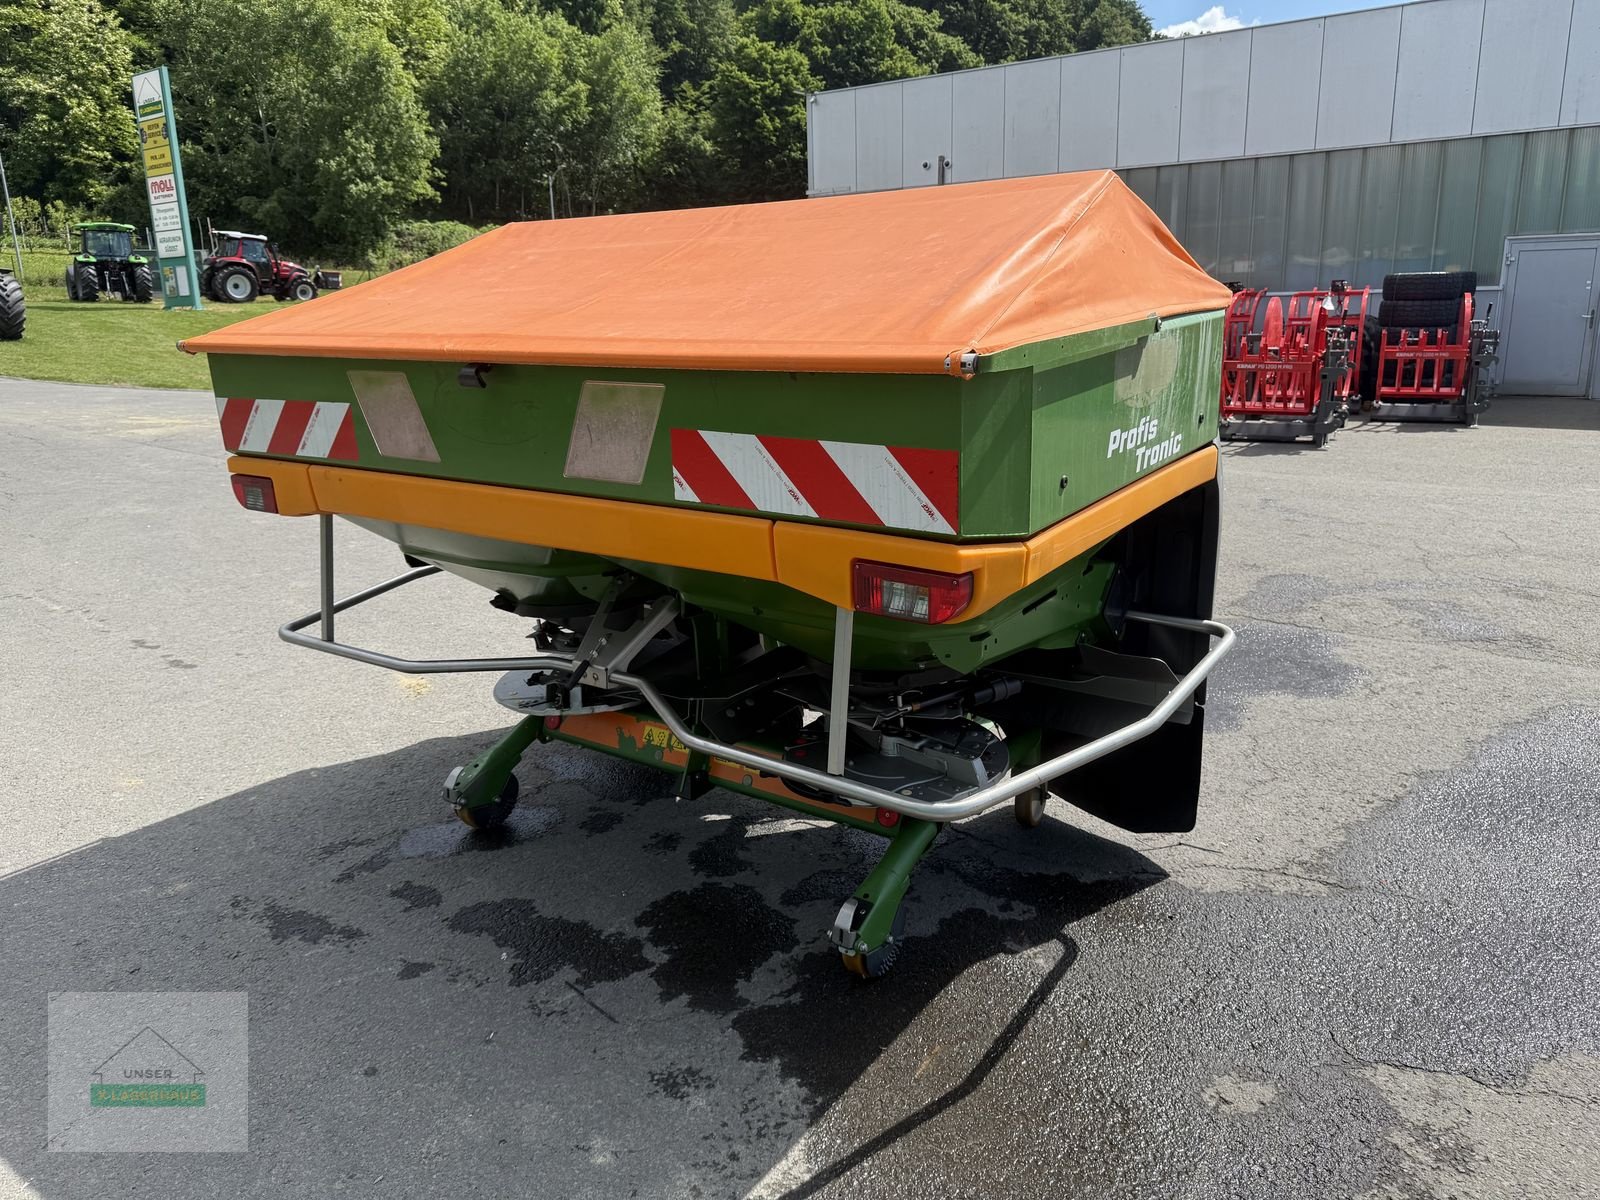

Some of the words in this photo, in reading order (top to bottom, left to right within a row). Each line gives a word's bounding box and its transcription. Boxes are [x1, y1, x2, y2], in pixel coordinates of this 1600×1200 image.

[150, 178, 174, 194] MOLL
[1107, 415, 1159, 458] Profis
[1135, 431, 1182, 473] Tronic
[787, 486, 800, 501] WGF
[920, 501, 935, 518] WGF
